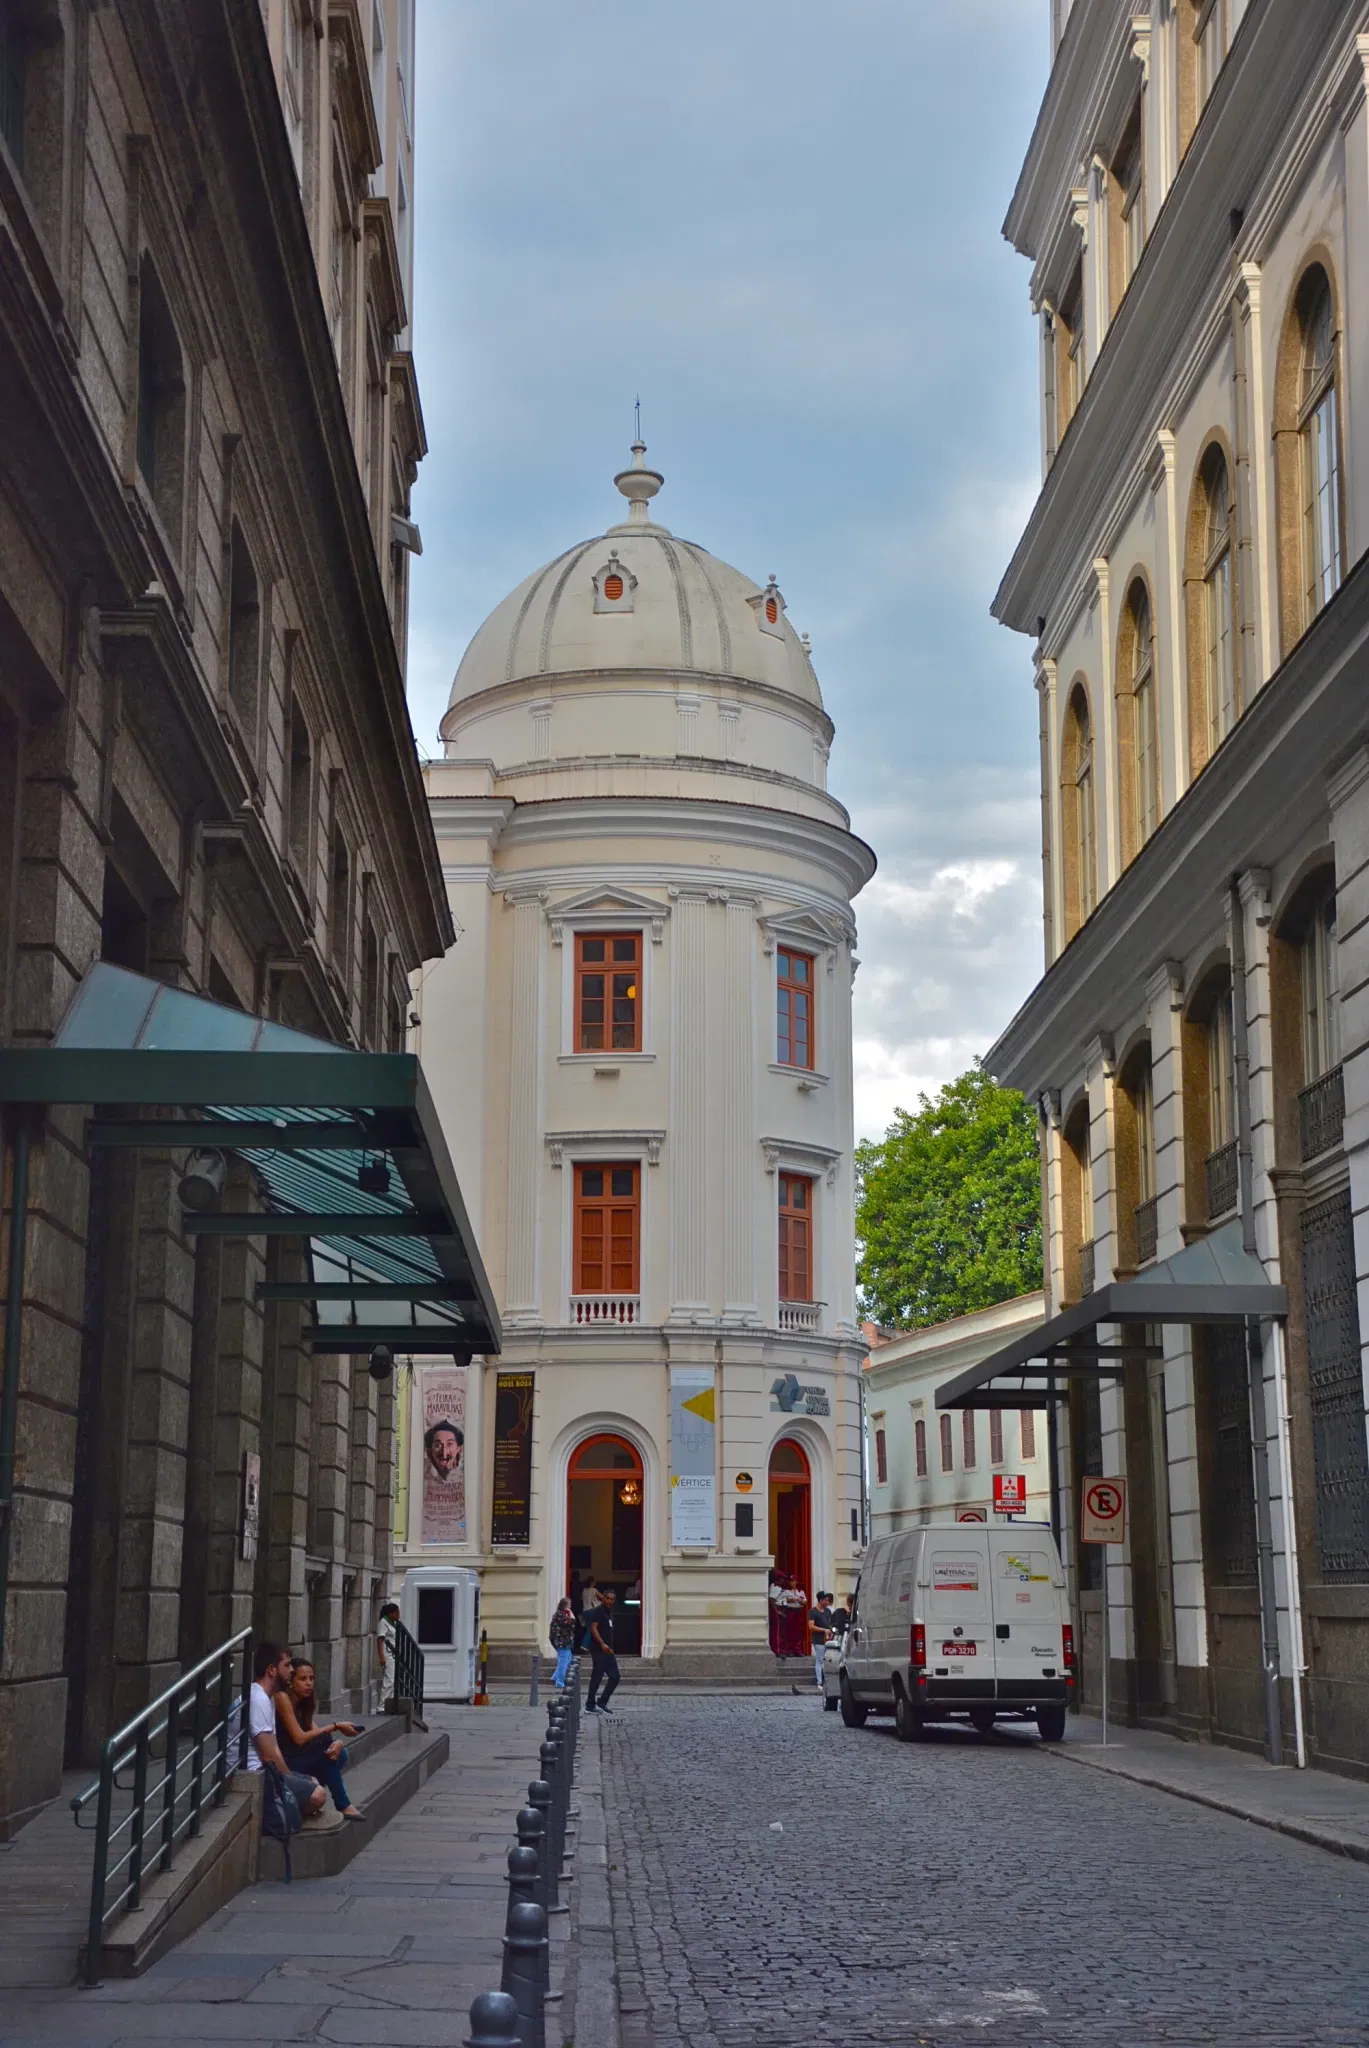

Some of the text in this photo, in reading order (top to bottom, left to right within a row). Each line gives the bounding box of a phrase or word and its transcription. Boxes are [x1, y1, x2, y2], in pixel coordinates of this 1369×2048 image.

[427, 1403, 463, 1415] MARAVILHAS
[676, 1477, 712, 1487] VÉRTICE
[1098, 1491, 1111, 1512] E
